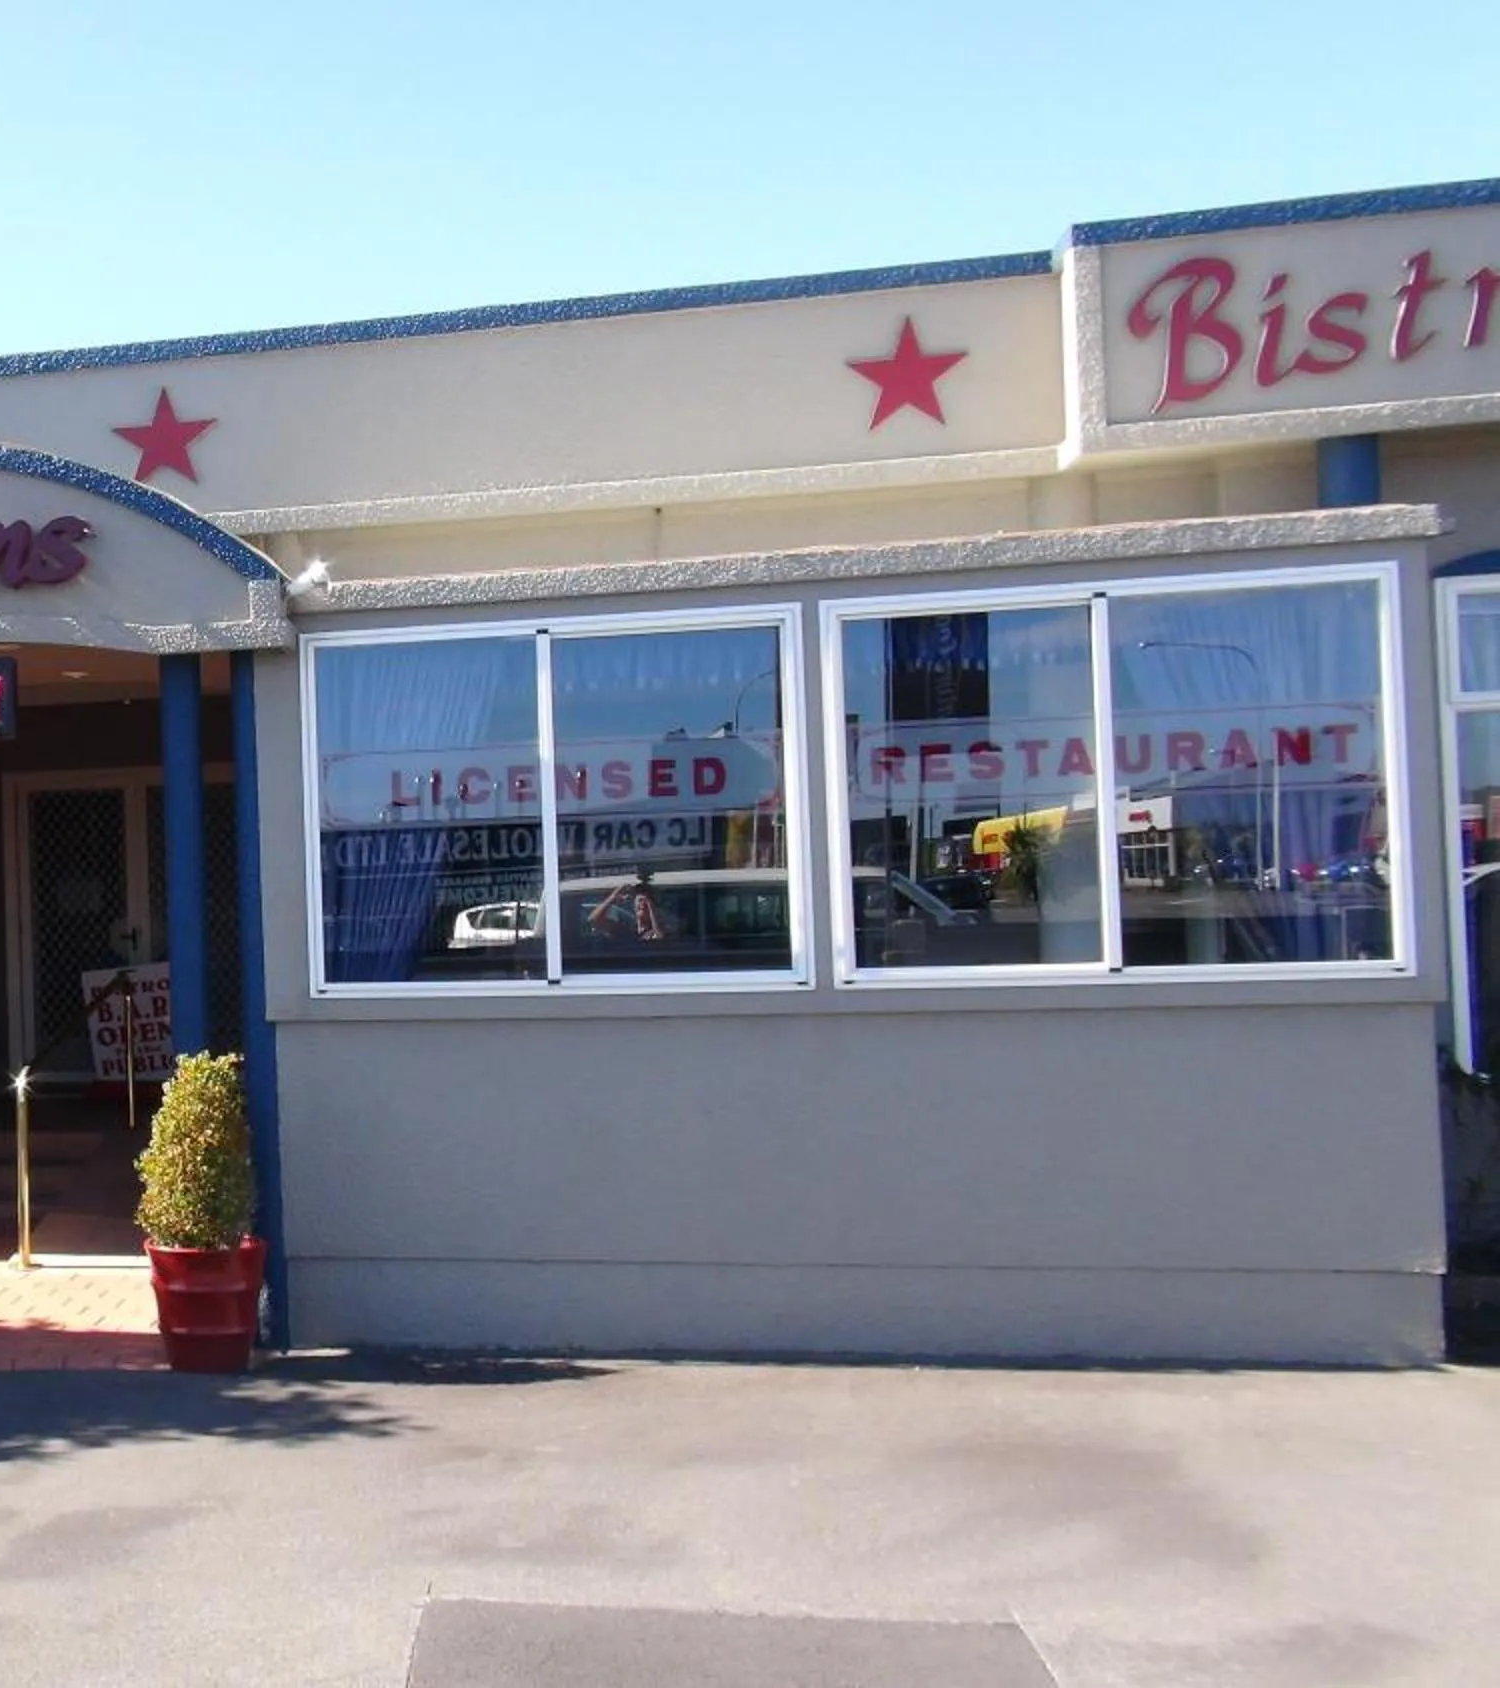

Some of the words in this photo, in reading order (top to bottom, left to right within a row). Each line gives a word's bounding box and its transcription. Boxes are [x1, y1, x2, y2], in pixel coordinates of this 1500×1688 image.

[391, 757, 728, 806] LICENSED
[871, 723, 1357, 785] RESTAURANT
[90, 977, 170, 1003] BTRO
[97, 1021, 171, 1046] OPEN
